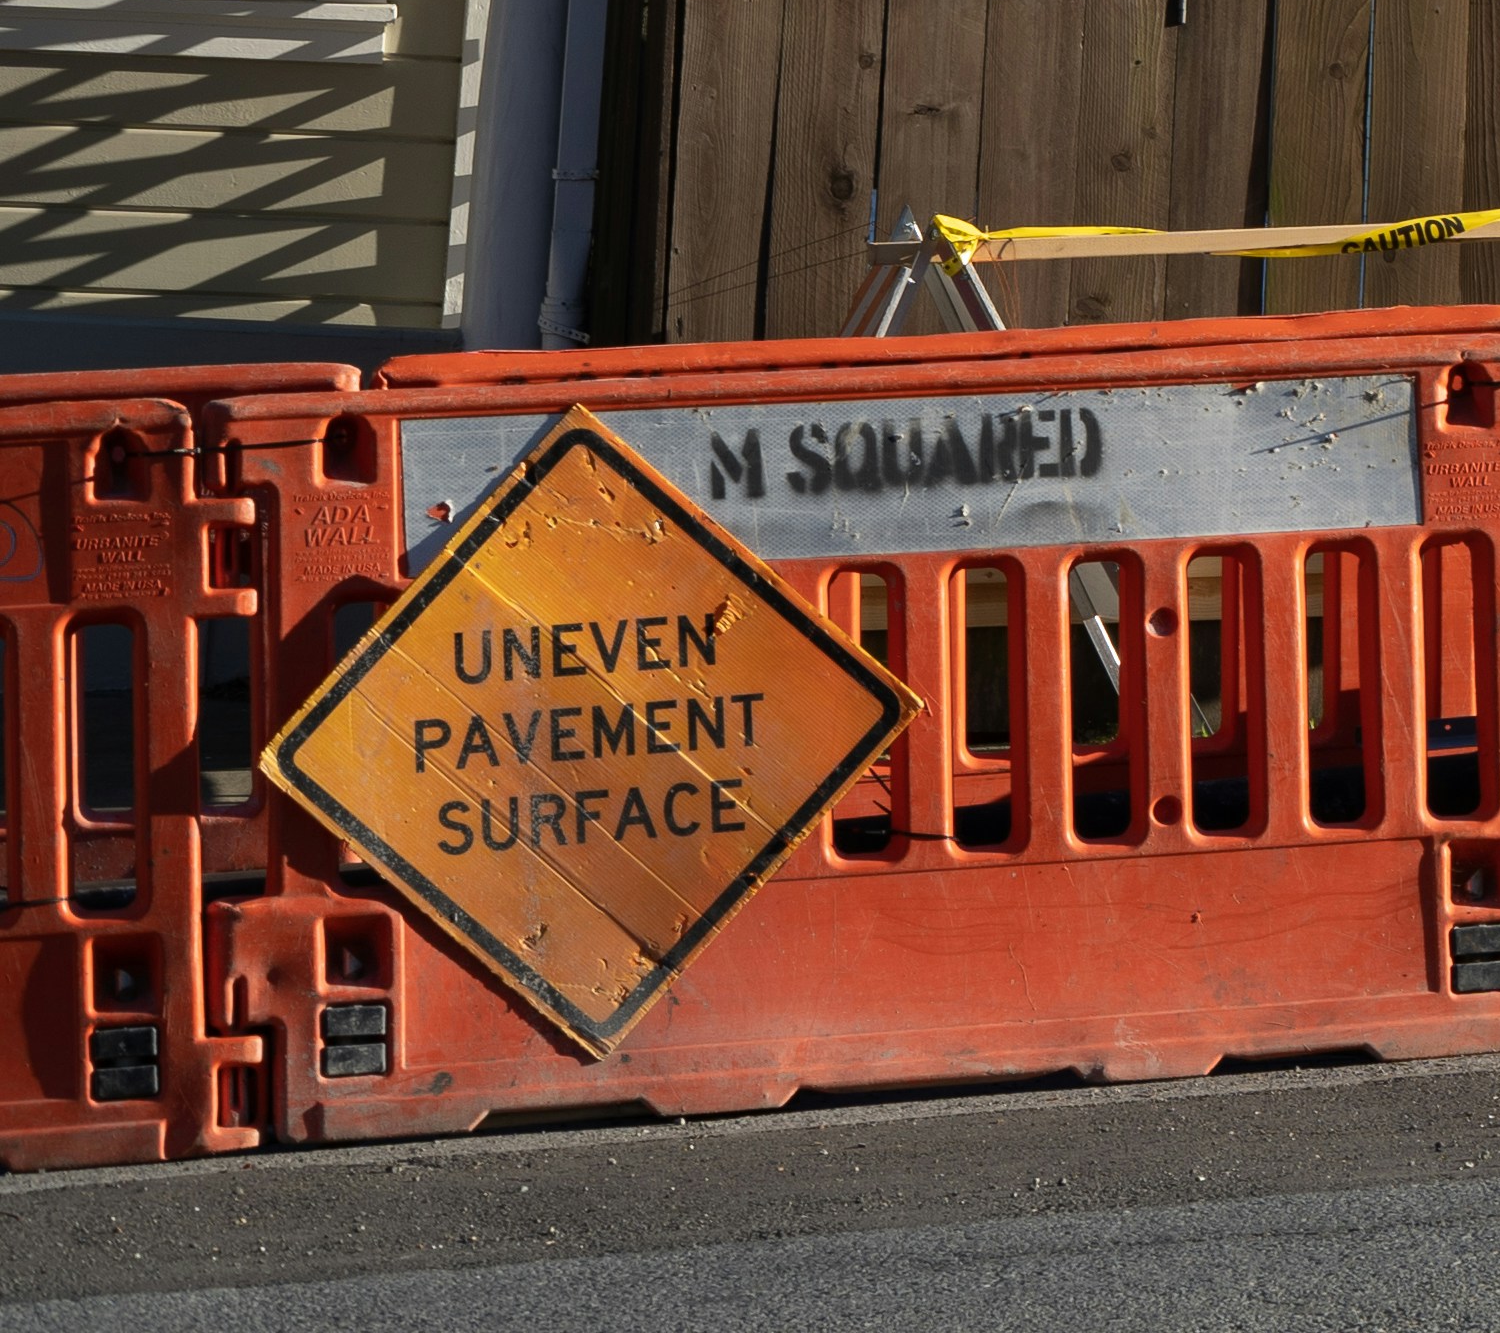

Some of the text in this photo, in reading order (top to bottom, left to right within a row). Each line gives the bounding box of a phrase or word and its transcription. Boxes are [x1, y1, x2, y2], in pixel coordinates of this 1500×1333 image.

[1341, 216, 1465, 254] CAUTION
[711, 407, 1102, 500] M SQUARED
[1449, 475, 1491, 488] WALL
[310, 504, 371, 526] ADA
[1435, 505, 1469, 516] MADE
[1470, 504, 1483, 515] IN
[74, 535, 159, 550] URBANITE
[304, 525, 380, 548] WALL
[98, 550, 145, 564] WALL
[303, 562, 381, 576] MADE IN USA
[82, 582, 120, 593] MADE
[136, 579, 162, 589] USA
[454, 613, 717, 685] UNEVEN
[414, 693, 764, 774] PAVEMENT
[437, 778, 747, 856] SURFACE
